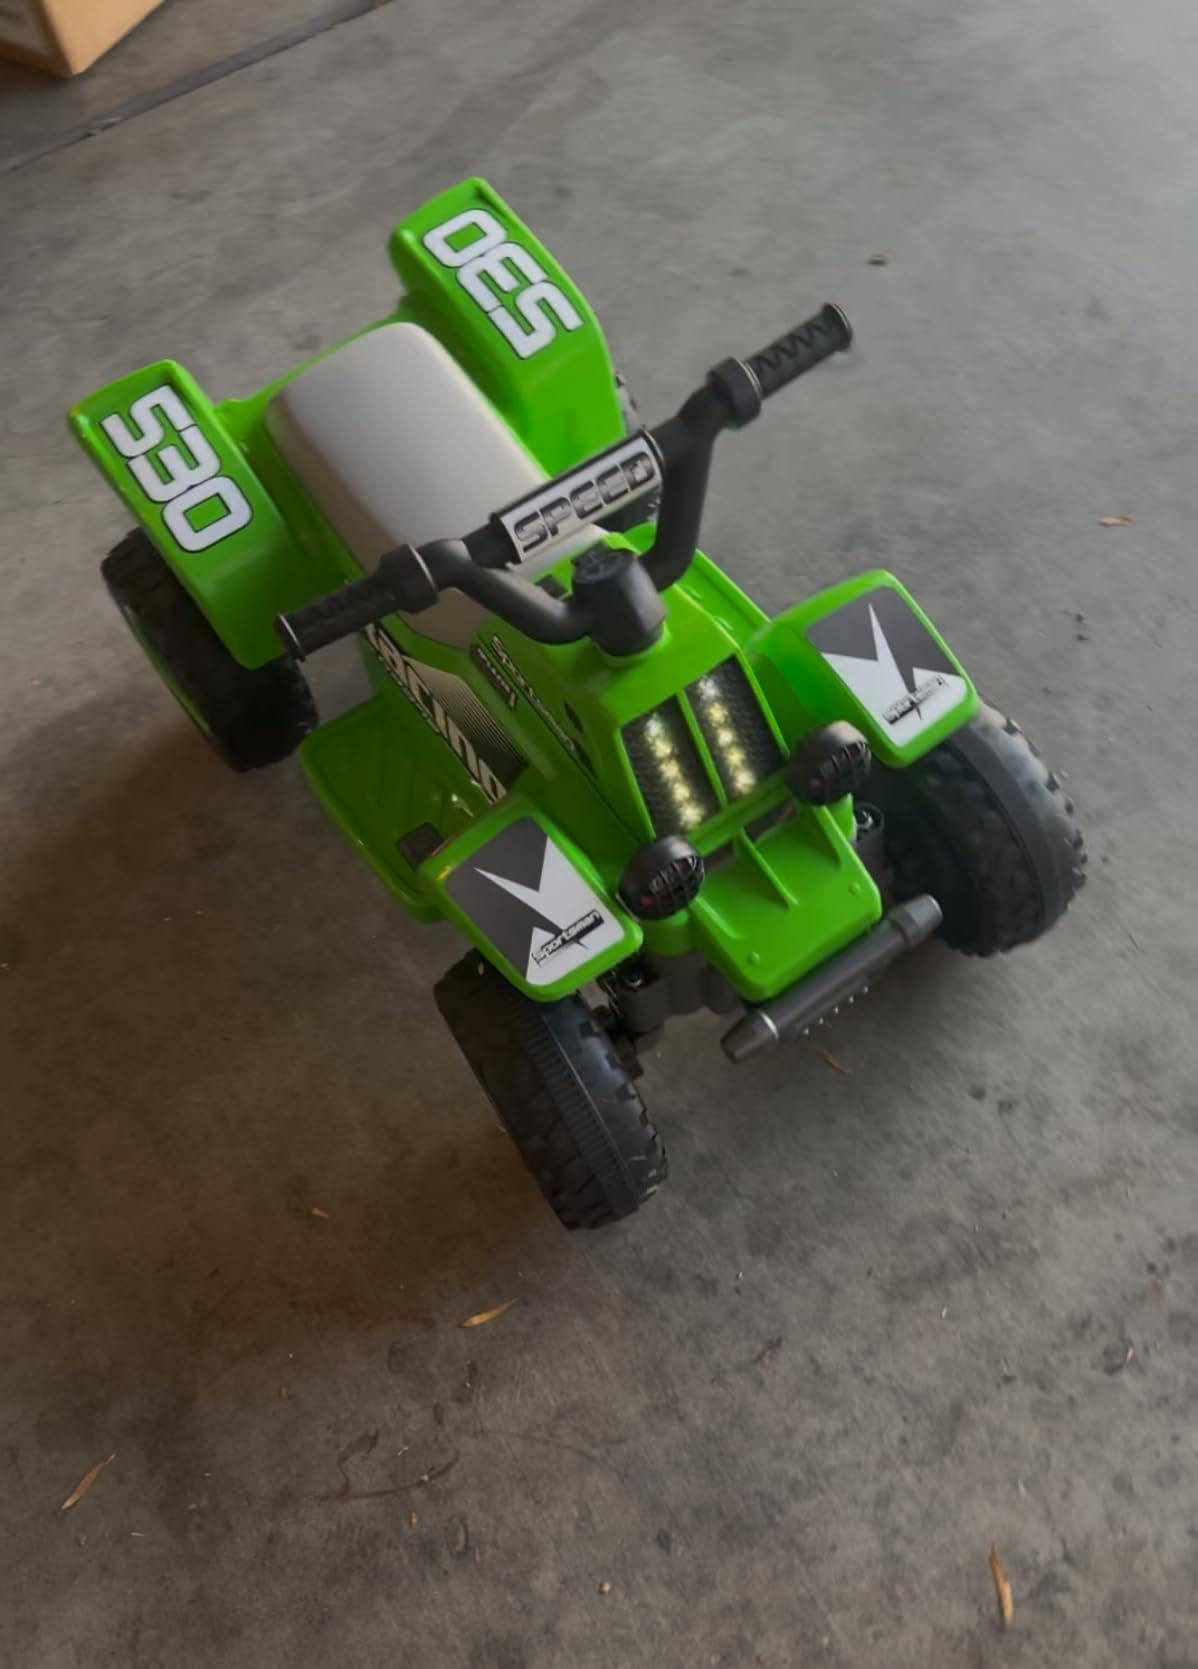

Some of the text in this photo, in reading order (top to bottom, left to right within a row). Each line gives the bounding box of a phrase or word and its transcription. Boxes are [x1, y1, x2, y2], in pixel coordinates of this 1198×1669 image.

[421, 208, 585, 360] 530
[98, 383, 253, 553] 530
[513, 451, 654, 553] SPEED
